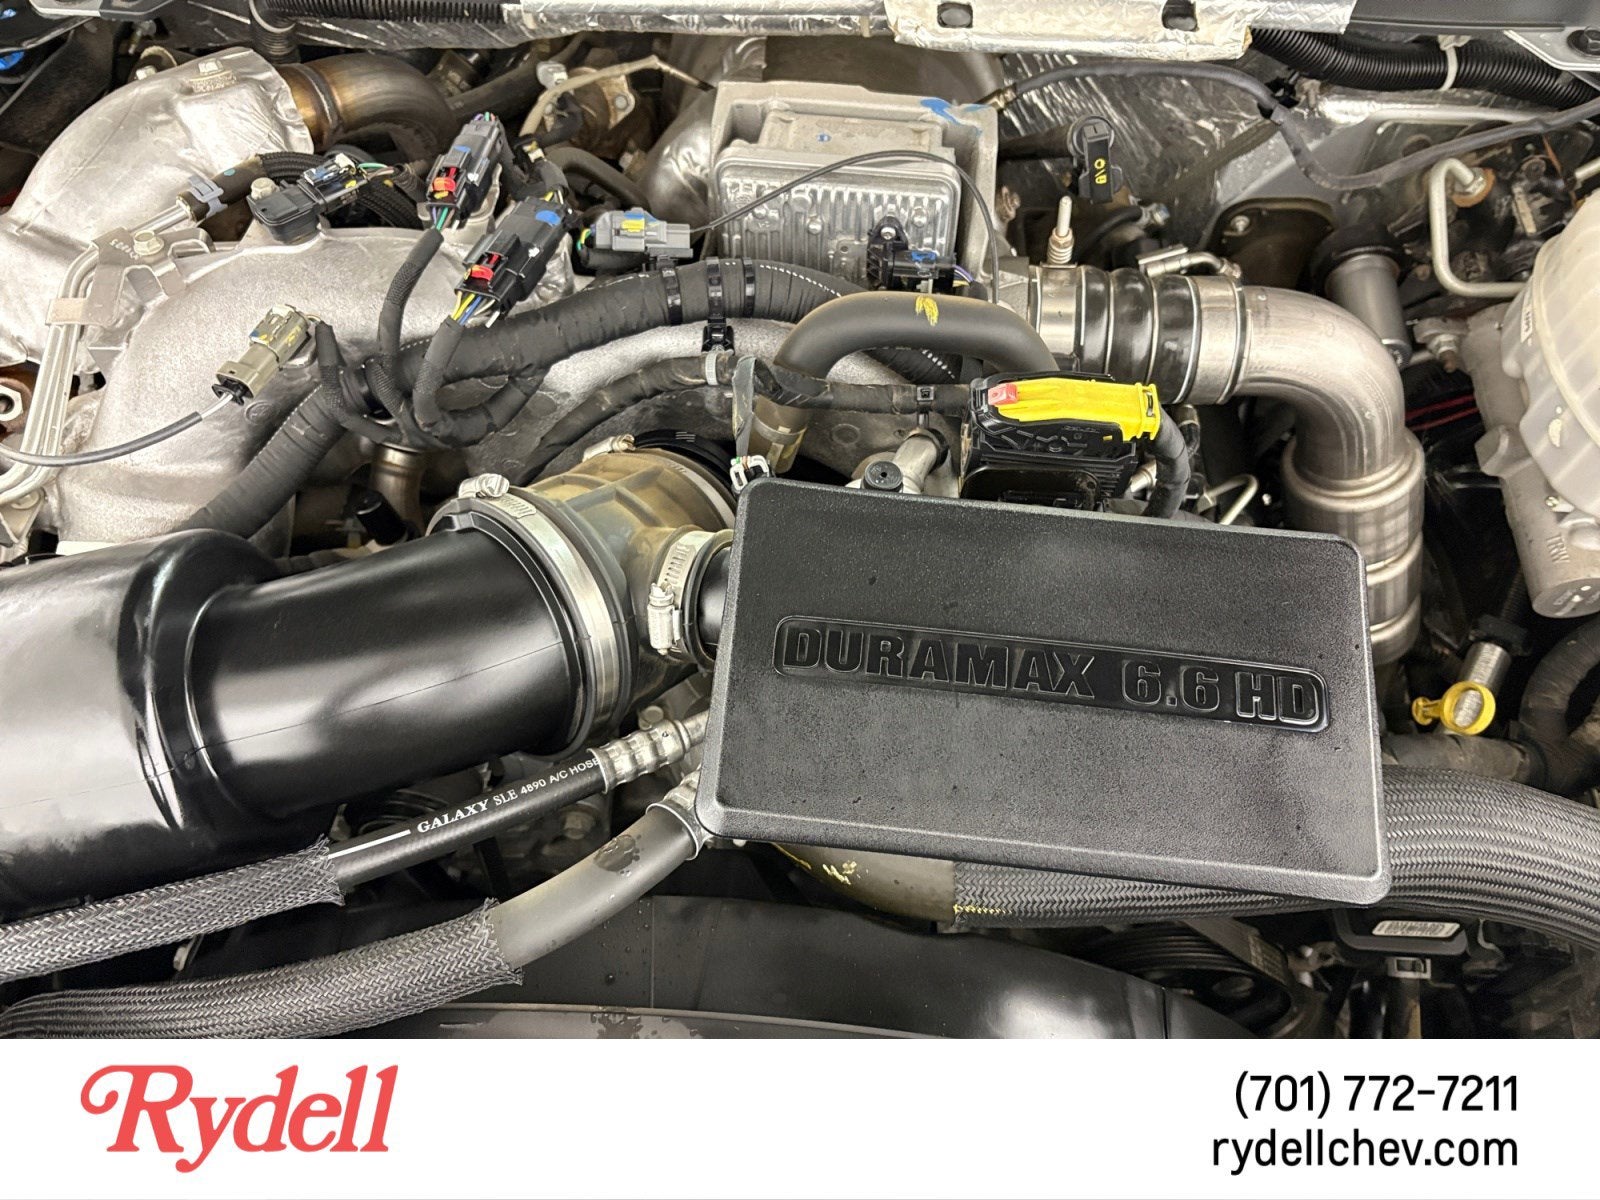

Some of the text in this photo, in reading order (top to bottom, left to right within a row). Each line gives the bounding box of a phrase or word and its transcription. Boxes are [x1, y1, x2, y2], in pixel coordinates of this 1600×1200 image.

[782, 627, 1320, 726] DURAMAX 6.6 HD
[417, 757, 600, 833] GALAXY SLE 4890 A/C HOSE
